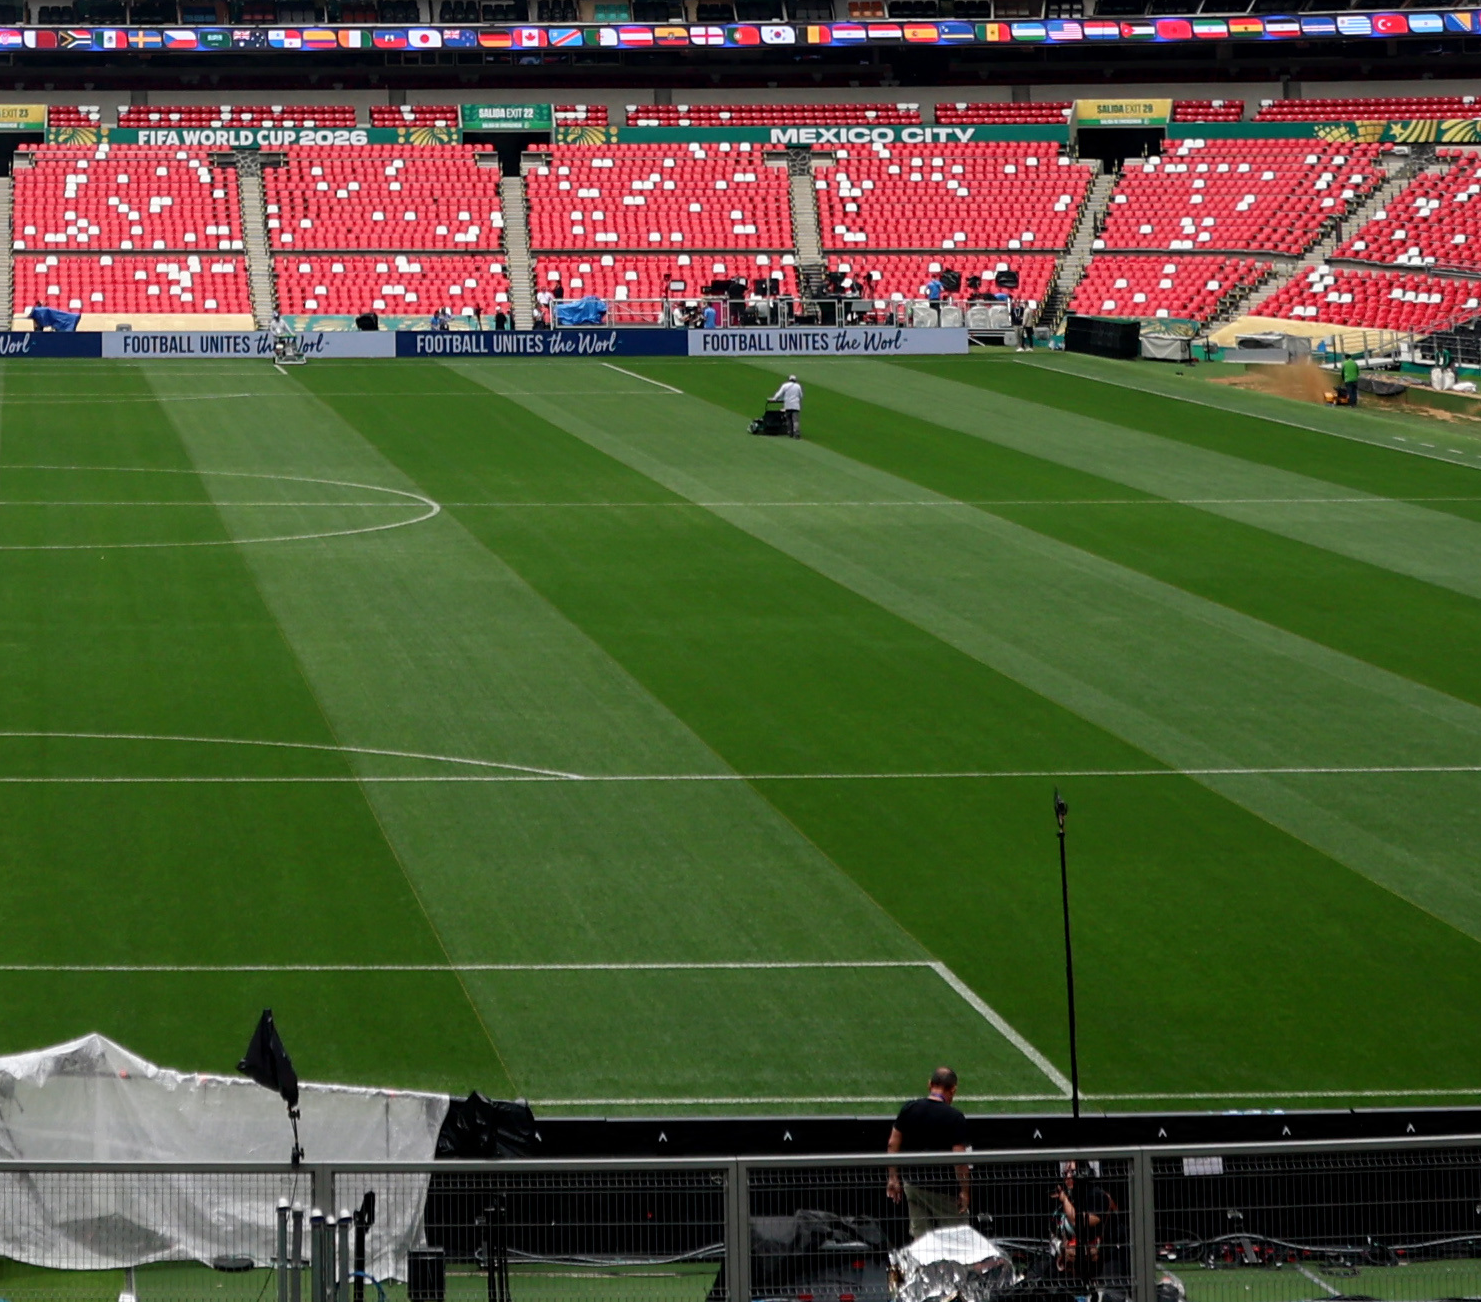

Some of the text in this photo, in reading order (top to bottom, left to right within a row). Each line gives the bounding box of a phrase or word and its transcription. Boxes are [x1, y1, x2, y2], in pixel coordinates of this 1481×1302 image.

[2, 109, 17, 118] EXIT
[19, 109, 29, 118] 23
[479, 108, 533, 118] SALIDA EXIT 22
[1097, 104, 1123, 114] SALIDA
[1125, 104, 1141, 113] EXIT
[138, 130, 368, 146] FIFA WORLD CUP 2026
[770, 128, 975, 144] MEXICO CITY
[124, 335, 194, 353] FOOTBALL
[200, 335, 250, 353] UNITES
[417, 335, 488, 353] FOOTBALL
[493, 335, 543, 353] UNITES
[547, 333, 575, 355] the
[703, 333, 773, 351] FOOTBALL
[779, 333, 829, 351] UNITES
[834, 332, 861, 353] the
